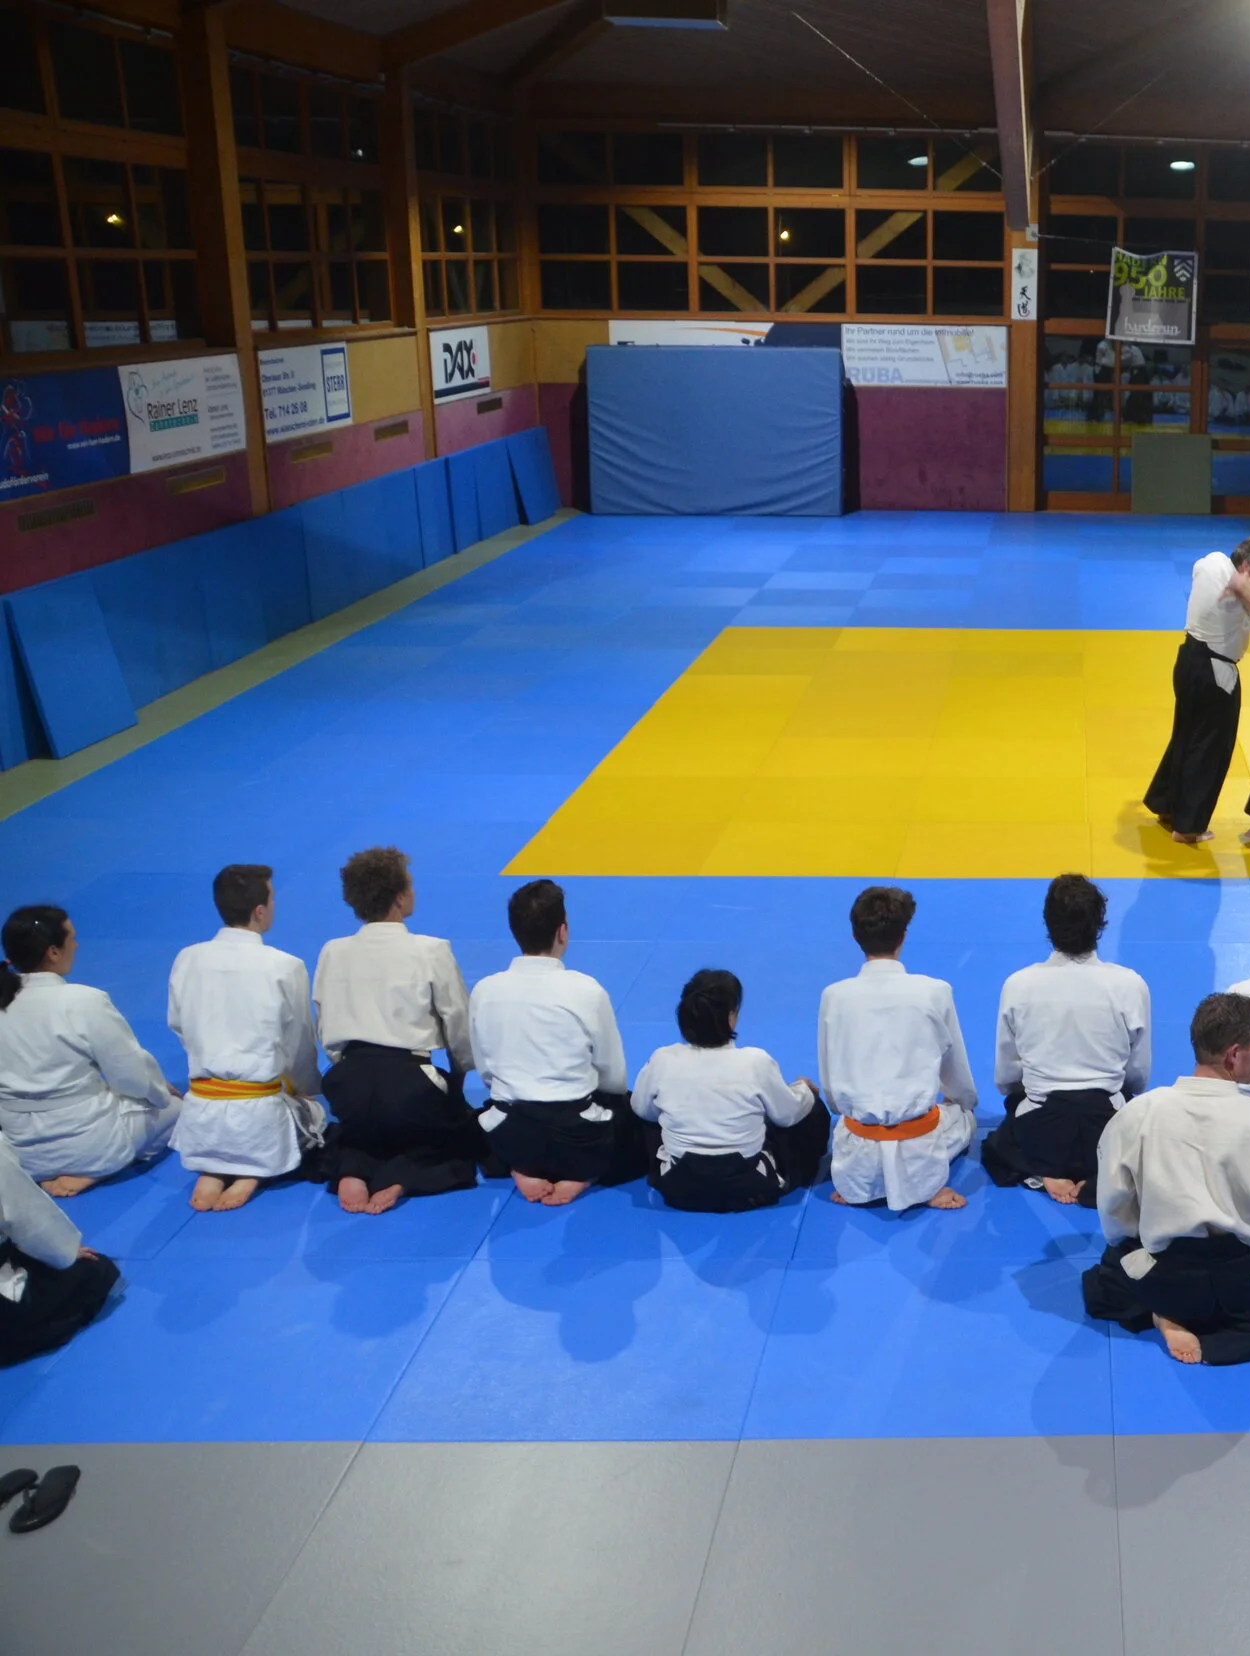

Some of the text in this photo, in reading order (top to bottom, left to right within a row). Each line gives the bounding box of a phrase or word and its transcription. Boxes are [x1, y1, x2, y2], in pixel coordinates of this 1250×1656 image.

[1114, 262, 1168, 289] 950
[1143, 286, 1186, 299] JAHRE
[857, 327, 885, 335] Partner
[887, 327, 905, 335] rund
[921, 328, 933, 336] die
[442, 339, 476, 384] DAX
[147, 400, 176, 419] Rainer
[177, 398, 199, 415] Lenz
[264, 407, 277, 420] Tel.
